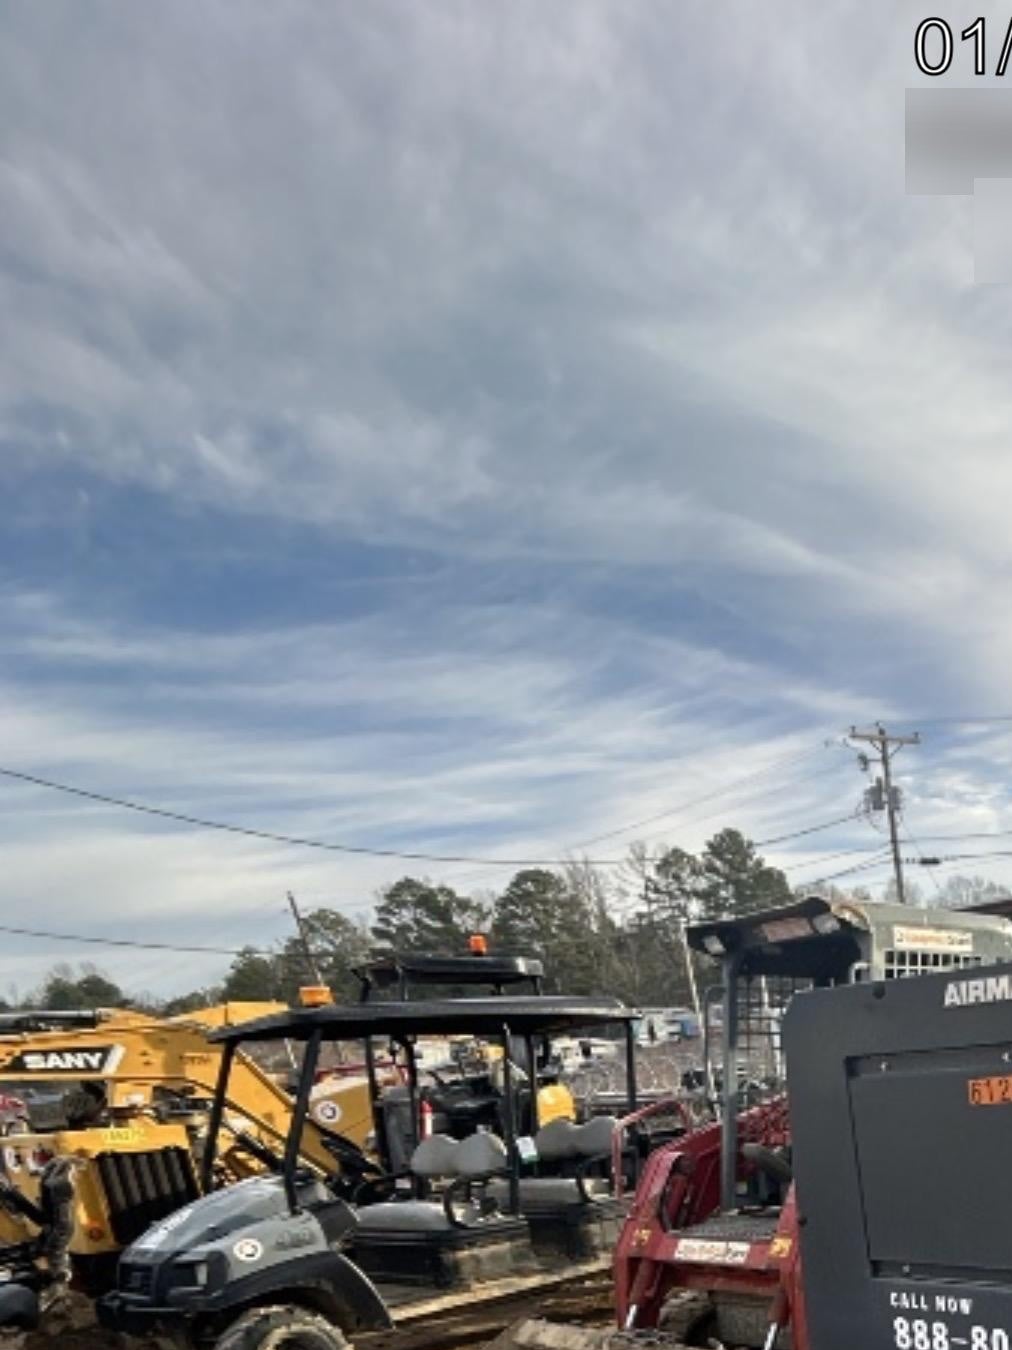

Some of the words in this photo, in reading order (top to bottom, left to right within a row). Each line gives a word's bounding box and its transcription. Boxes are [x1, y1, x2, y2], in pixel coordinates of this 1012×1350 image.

[23, 1052, 103, 1069] SANY
[890, 1292, 928, 1311] CALL
[935, 1295, 974, 1315] NOW
